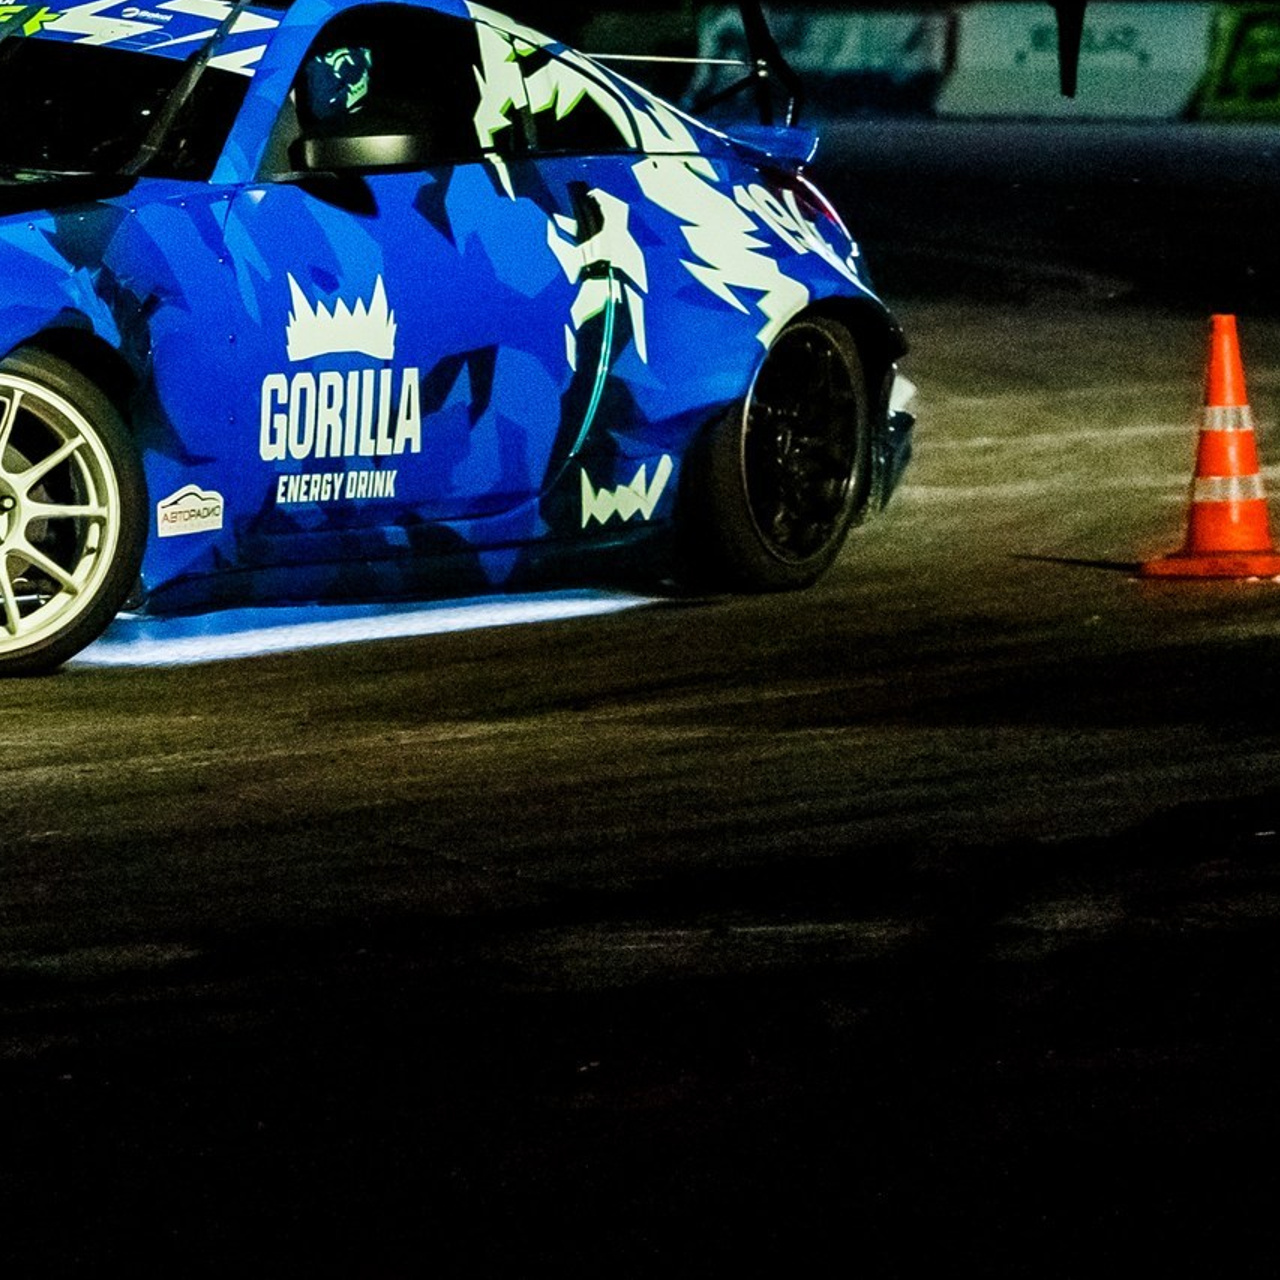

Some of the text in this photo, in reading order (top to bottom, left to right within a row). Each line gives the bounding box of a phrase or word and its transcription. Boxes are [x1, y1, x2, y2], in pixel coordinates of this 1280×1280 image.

[259, 367, 421, 461] GORILLA
[276, 470, 397, 503] ENERGY DRINK
